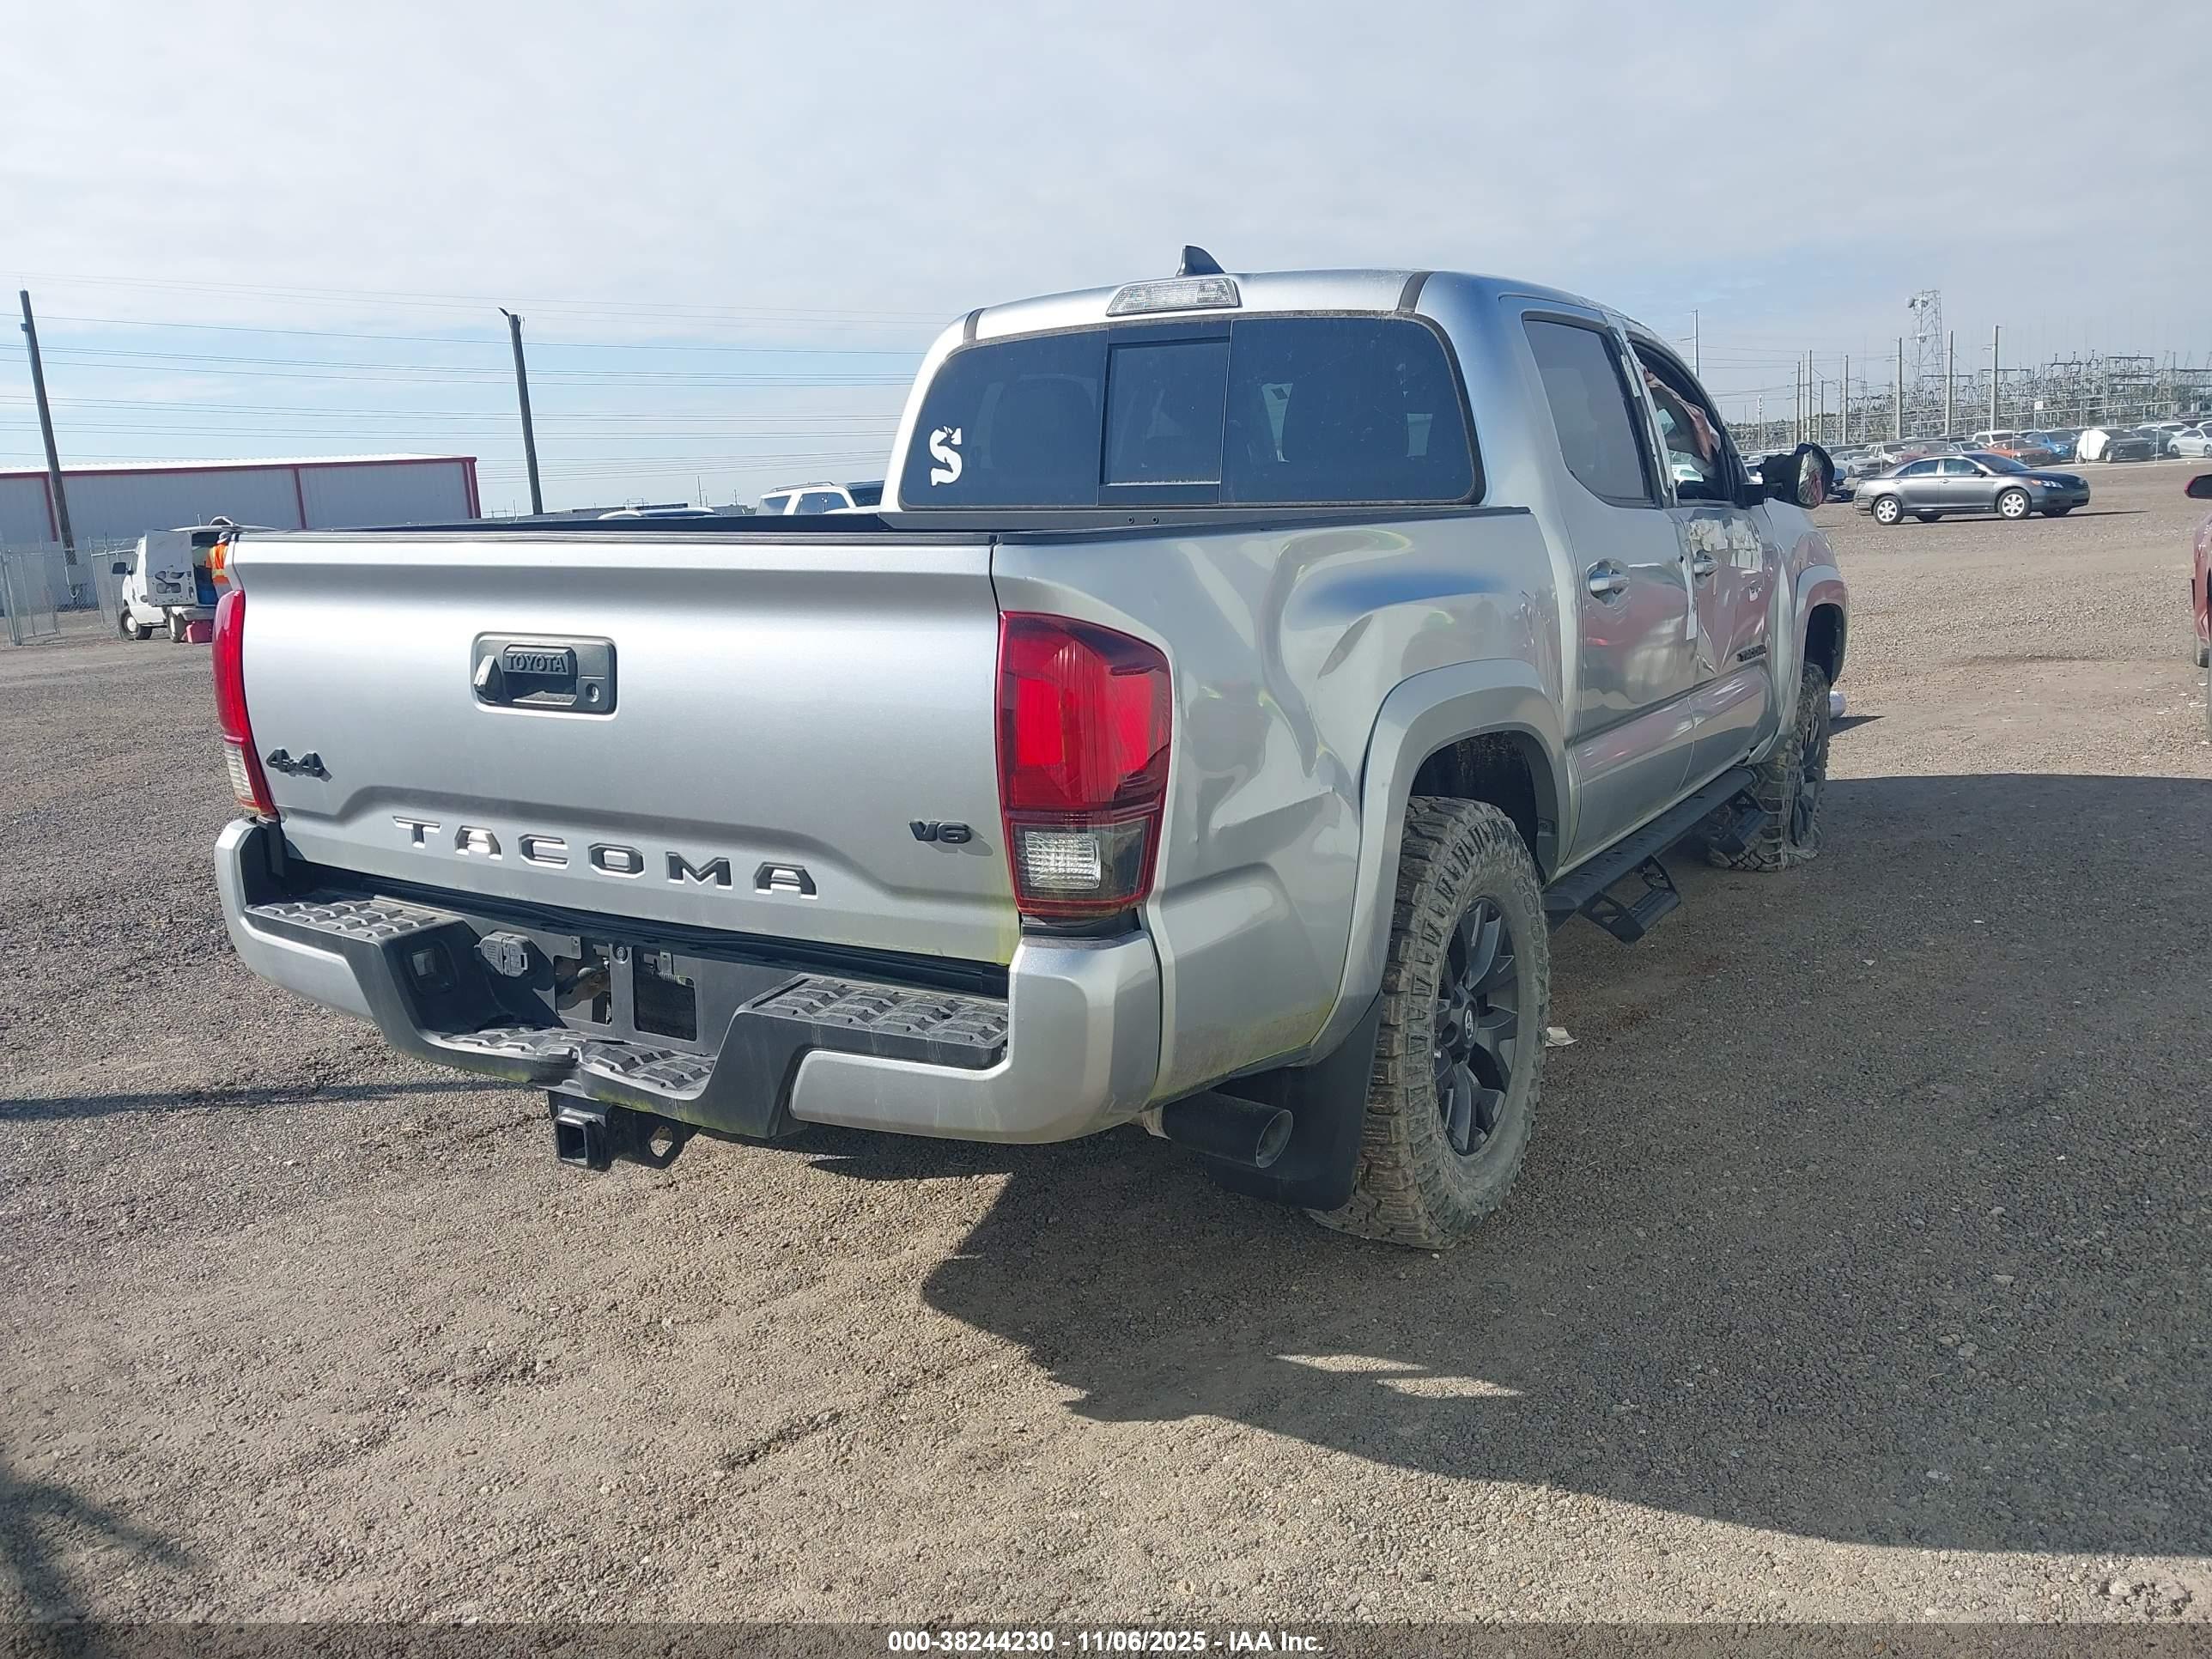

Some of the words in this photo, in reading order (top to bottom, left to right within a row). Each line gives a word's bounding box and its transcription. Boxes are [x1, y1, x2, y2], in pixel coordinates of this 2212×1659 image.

[505, 653, 567, 673] TOYOTA
[908, 820, 972, 844] V6
[393, 815, 818, 900] TACOMA
